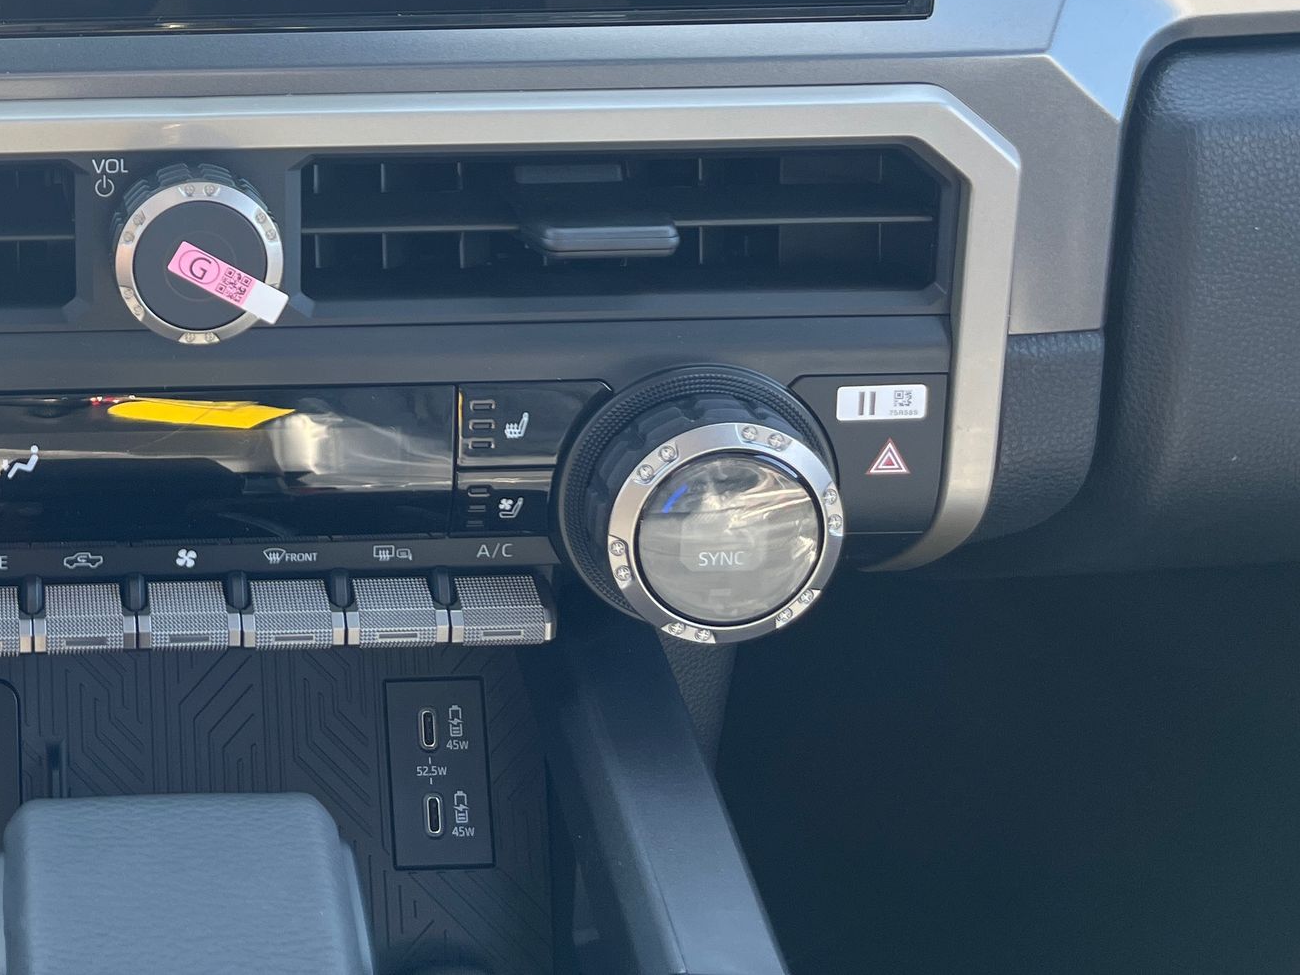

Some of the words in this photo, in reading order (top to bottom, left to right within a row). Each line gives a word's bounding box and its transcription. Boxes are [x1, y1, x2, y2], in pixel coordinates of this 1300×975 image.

[92, 158, 129, 174] VOL
[189, 256, 213, 281] G
[285, 552, 318, 563] FRONT
[476, 543, 514, 559] A/C
[698, 551, 746, 566] SYNC
[446, 739, 469, 750] 45W
[416, 766, 447, 776] 52.5W
[451, 826, 475, 837] 45W
